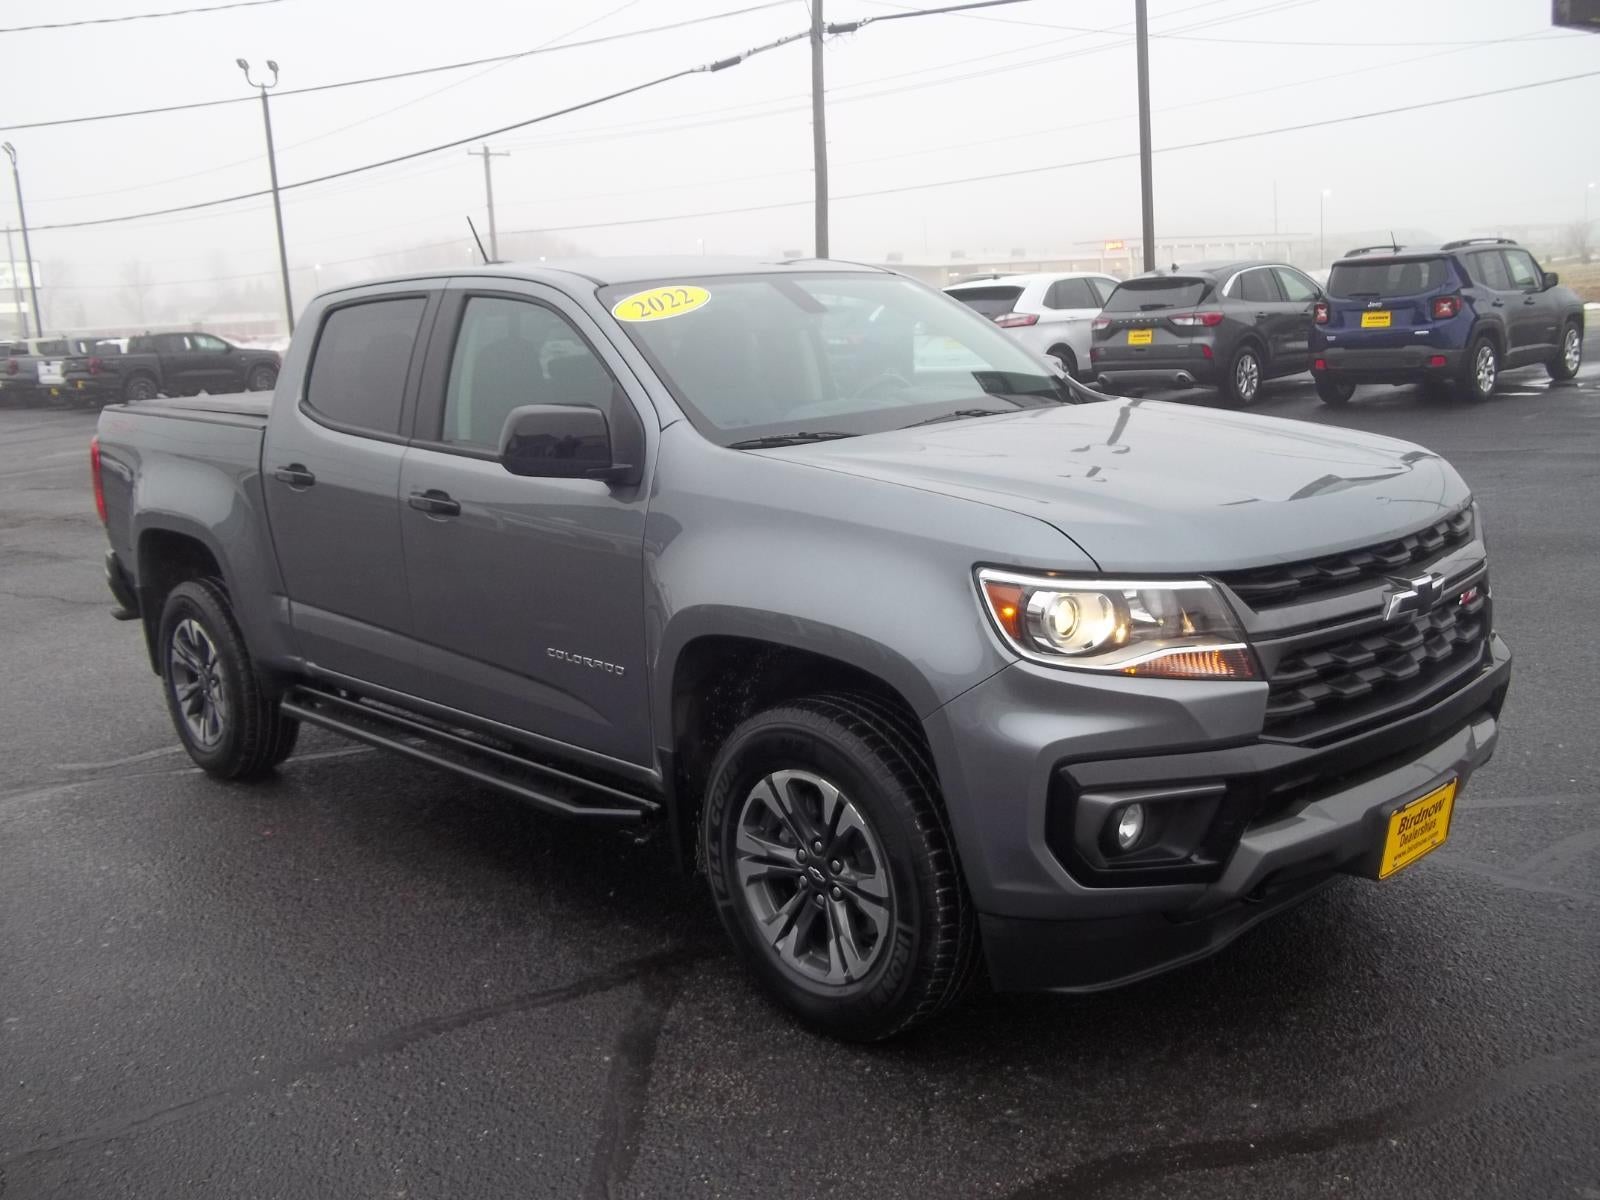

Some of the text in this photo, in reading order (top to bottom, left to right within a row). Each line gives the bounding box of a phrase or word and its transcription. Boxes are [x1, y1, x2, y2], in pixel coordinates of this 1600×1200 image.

[631, 288, 695, 317] 2022
[546, 647, 625, 675] COLORADO
[1397, 798, 1446, 836] Birdnow
